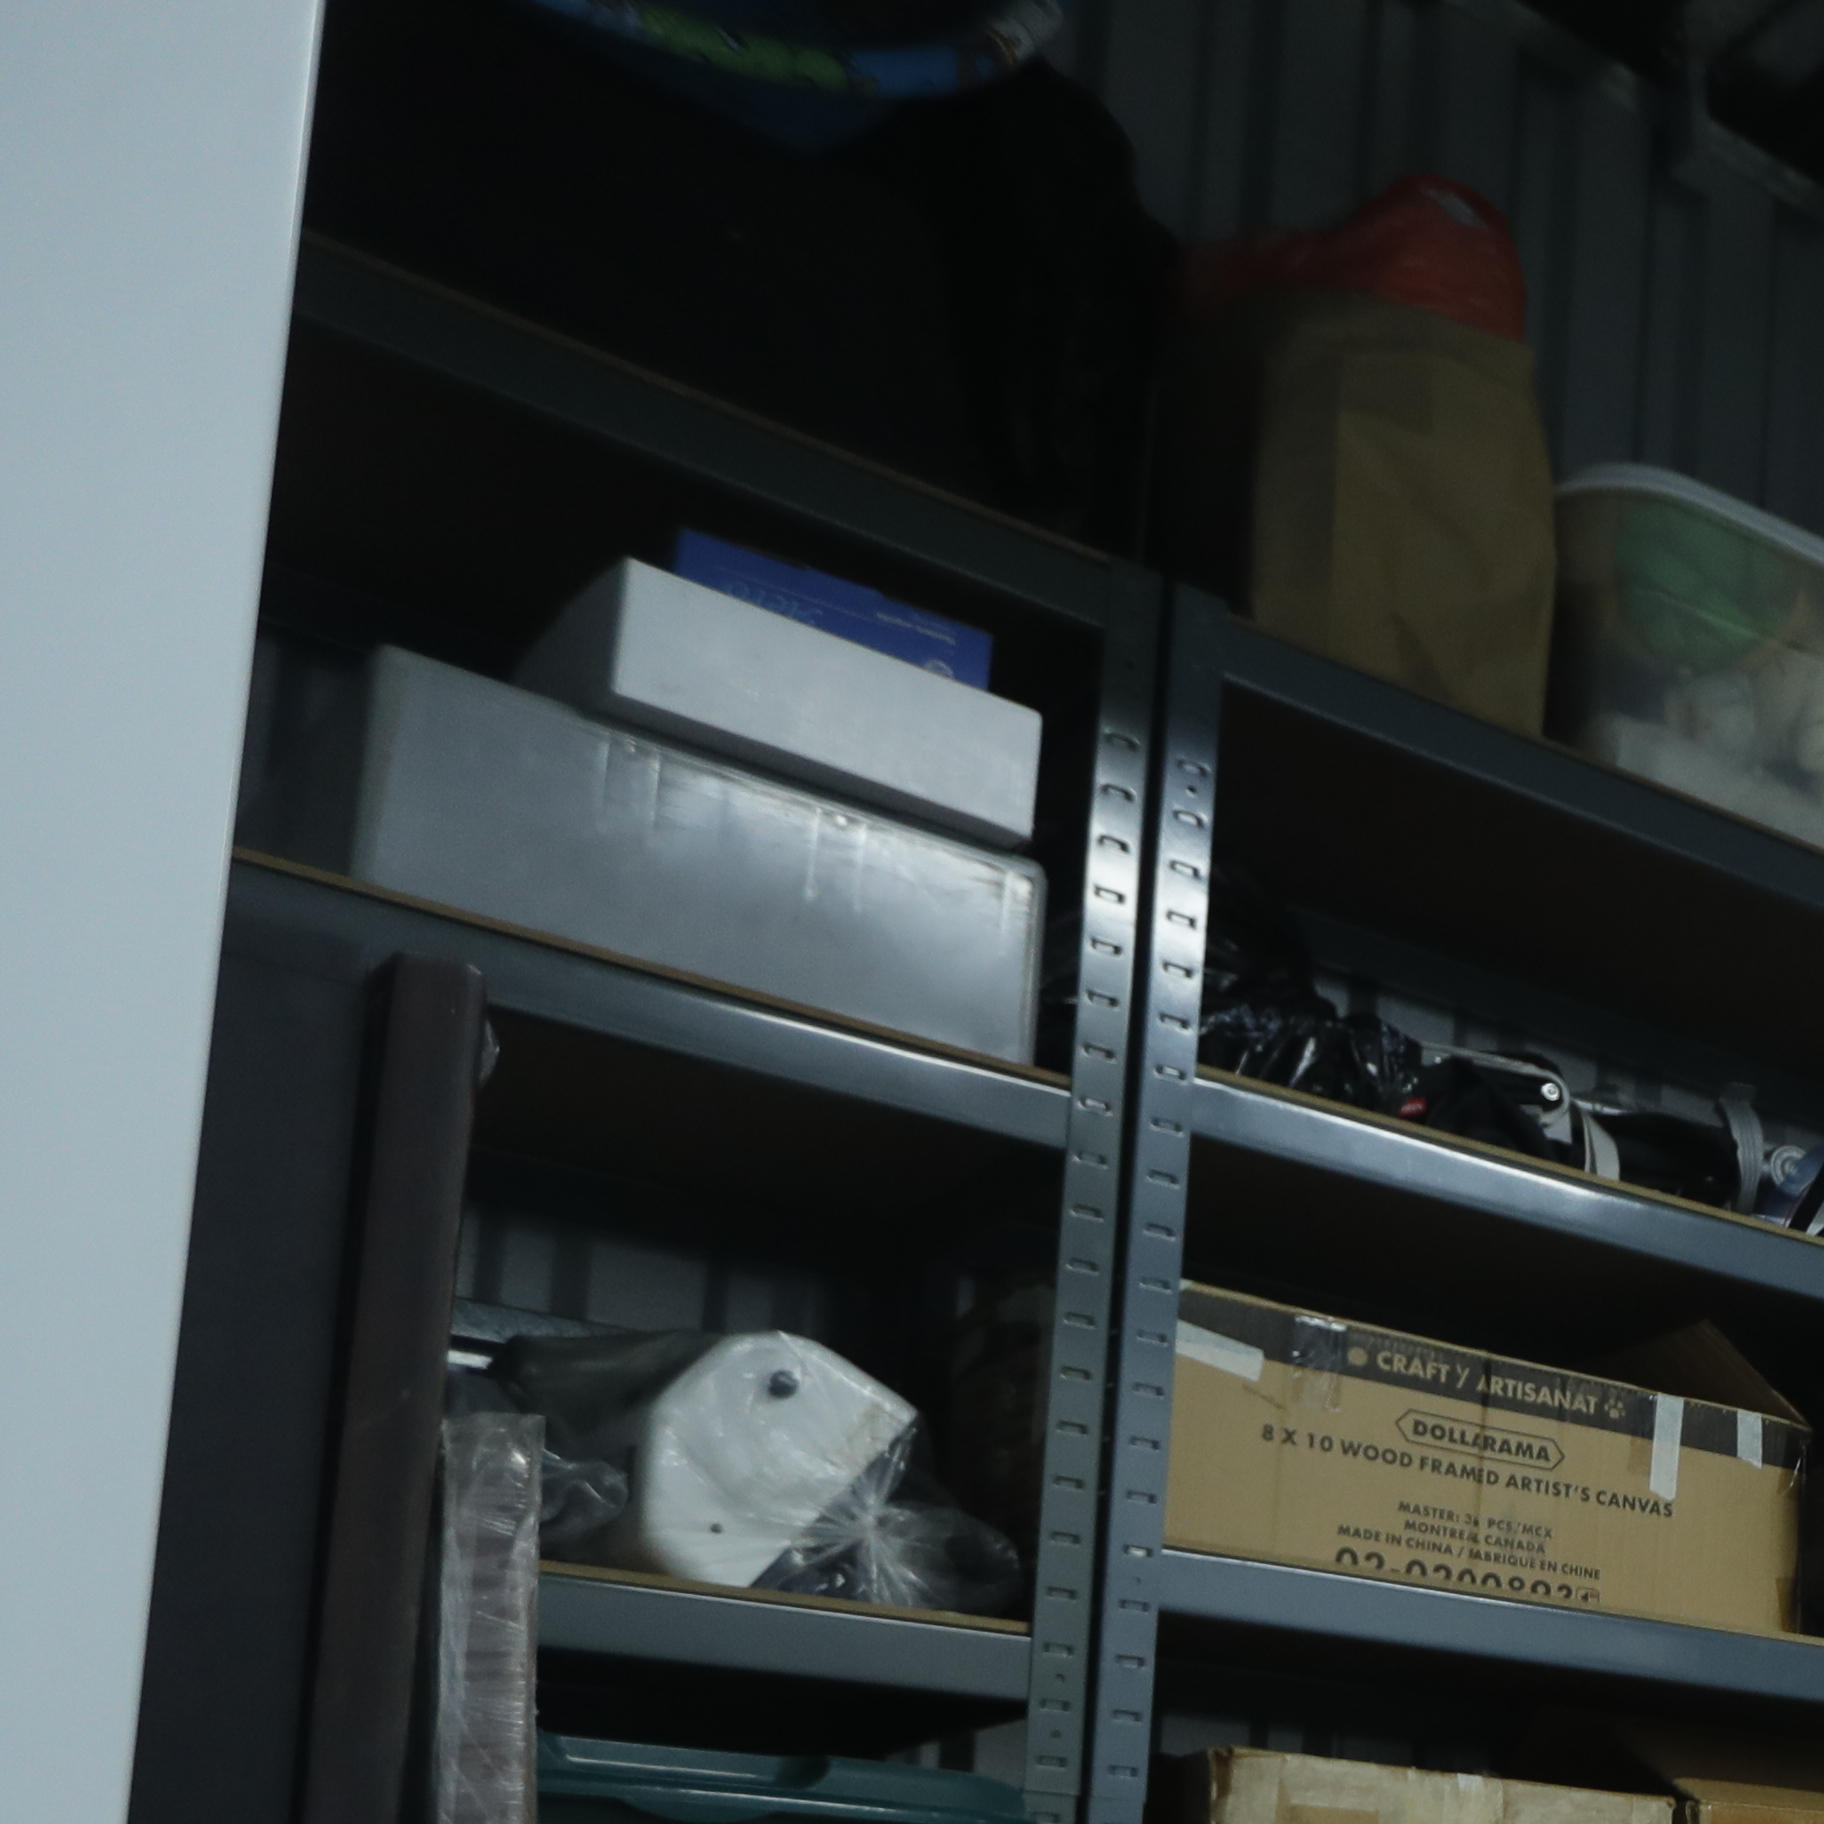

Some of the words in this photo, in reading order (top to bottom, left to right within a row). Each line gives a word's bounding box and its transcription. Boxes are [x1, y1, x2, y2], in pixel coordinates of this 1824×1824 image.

[1376, 1350, 1450, 1383] CRAFT
[1477, 1374, 1598, 1416] ARTISANAT
[1412, 1418, 1551, 1463] DOLLARAMA
[1261, 1423, 1275, 1442] 8
[1282, 1428, 1299, 1446] X
[1307, 1432, 1334, 1453] 10
[1340, 1439, 1413, 1468] WOOD
[1420, 1455, 1500, 1486] FRAMED
[1505, 1474, 1591, 1503] ARTIST'S
[1596, 1489, 1674, 1518] CANVAS
[1397, 1500, 1461, 1523] MASTER:
[1403, 1520, 1479, 1543] MONTREAL
[1484, 1534, 1546, 1554] CANADA
[1337, 1524, 1381, 1543] MADE
[1385, 1533, 1402, 1546] IN
[1406, 1537, 1454, 1556] CHINA
[1468, 1547, 1535, 1569] FABRIQUE
[1539, 1559, 1558, 1573] EN
[1561, 1562, 1601, 1581] CHINE
